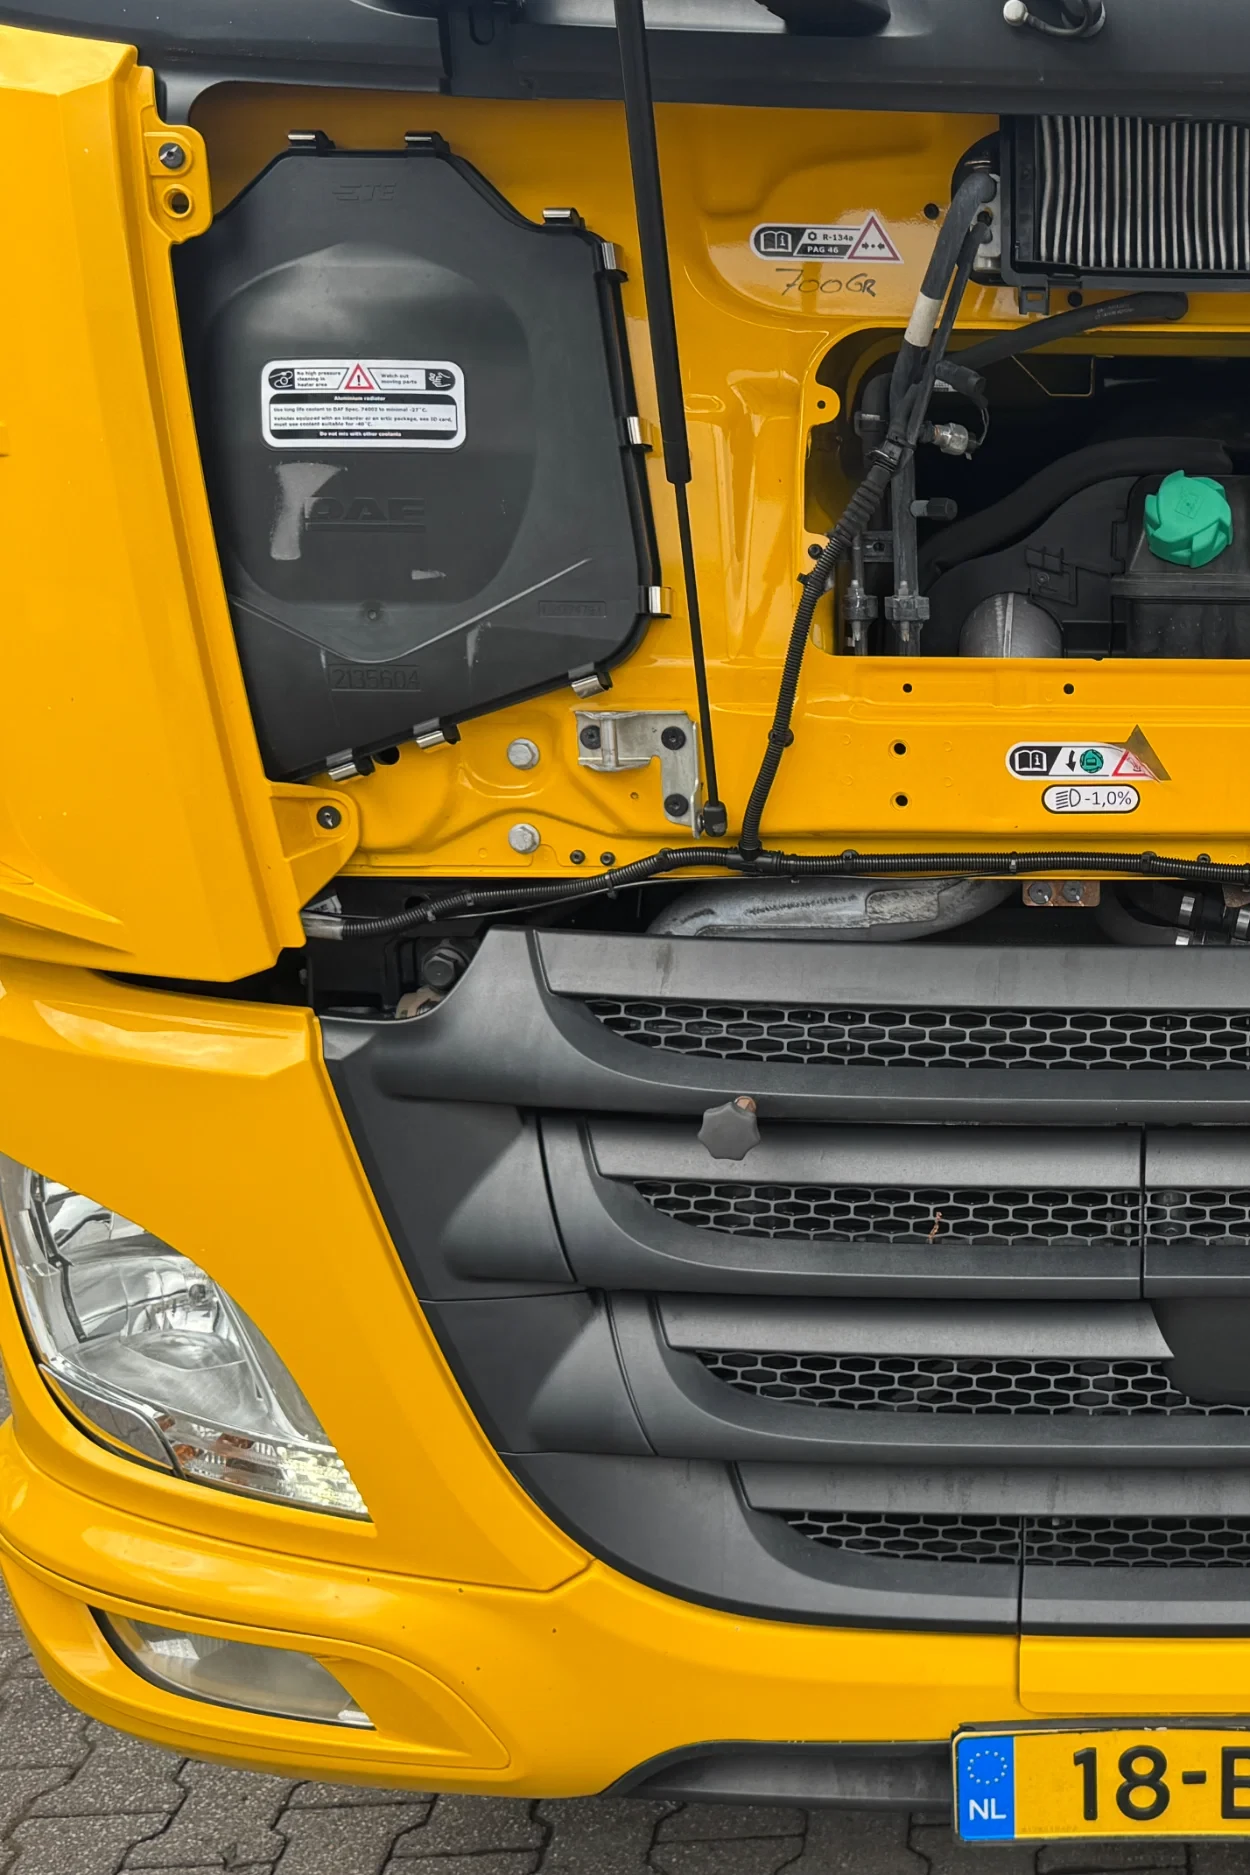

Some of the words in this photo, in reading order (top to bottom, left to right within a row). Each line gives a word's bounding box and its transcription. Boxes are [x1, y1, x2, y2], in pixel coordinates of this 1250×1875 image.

[822, 233, 854, 242] R-134a
[807, 246, 825, 254] PAG
[827, 246, 839, 254] 46
[1084, 790, 1132, 808] -1,0%
[968, 1797, 1007, 1821] NL
